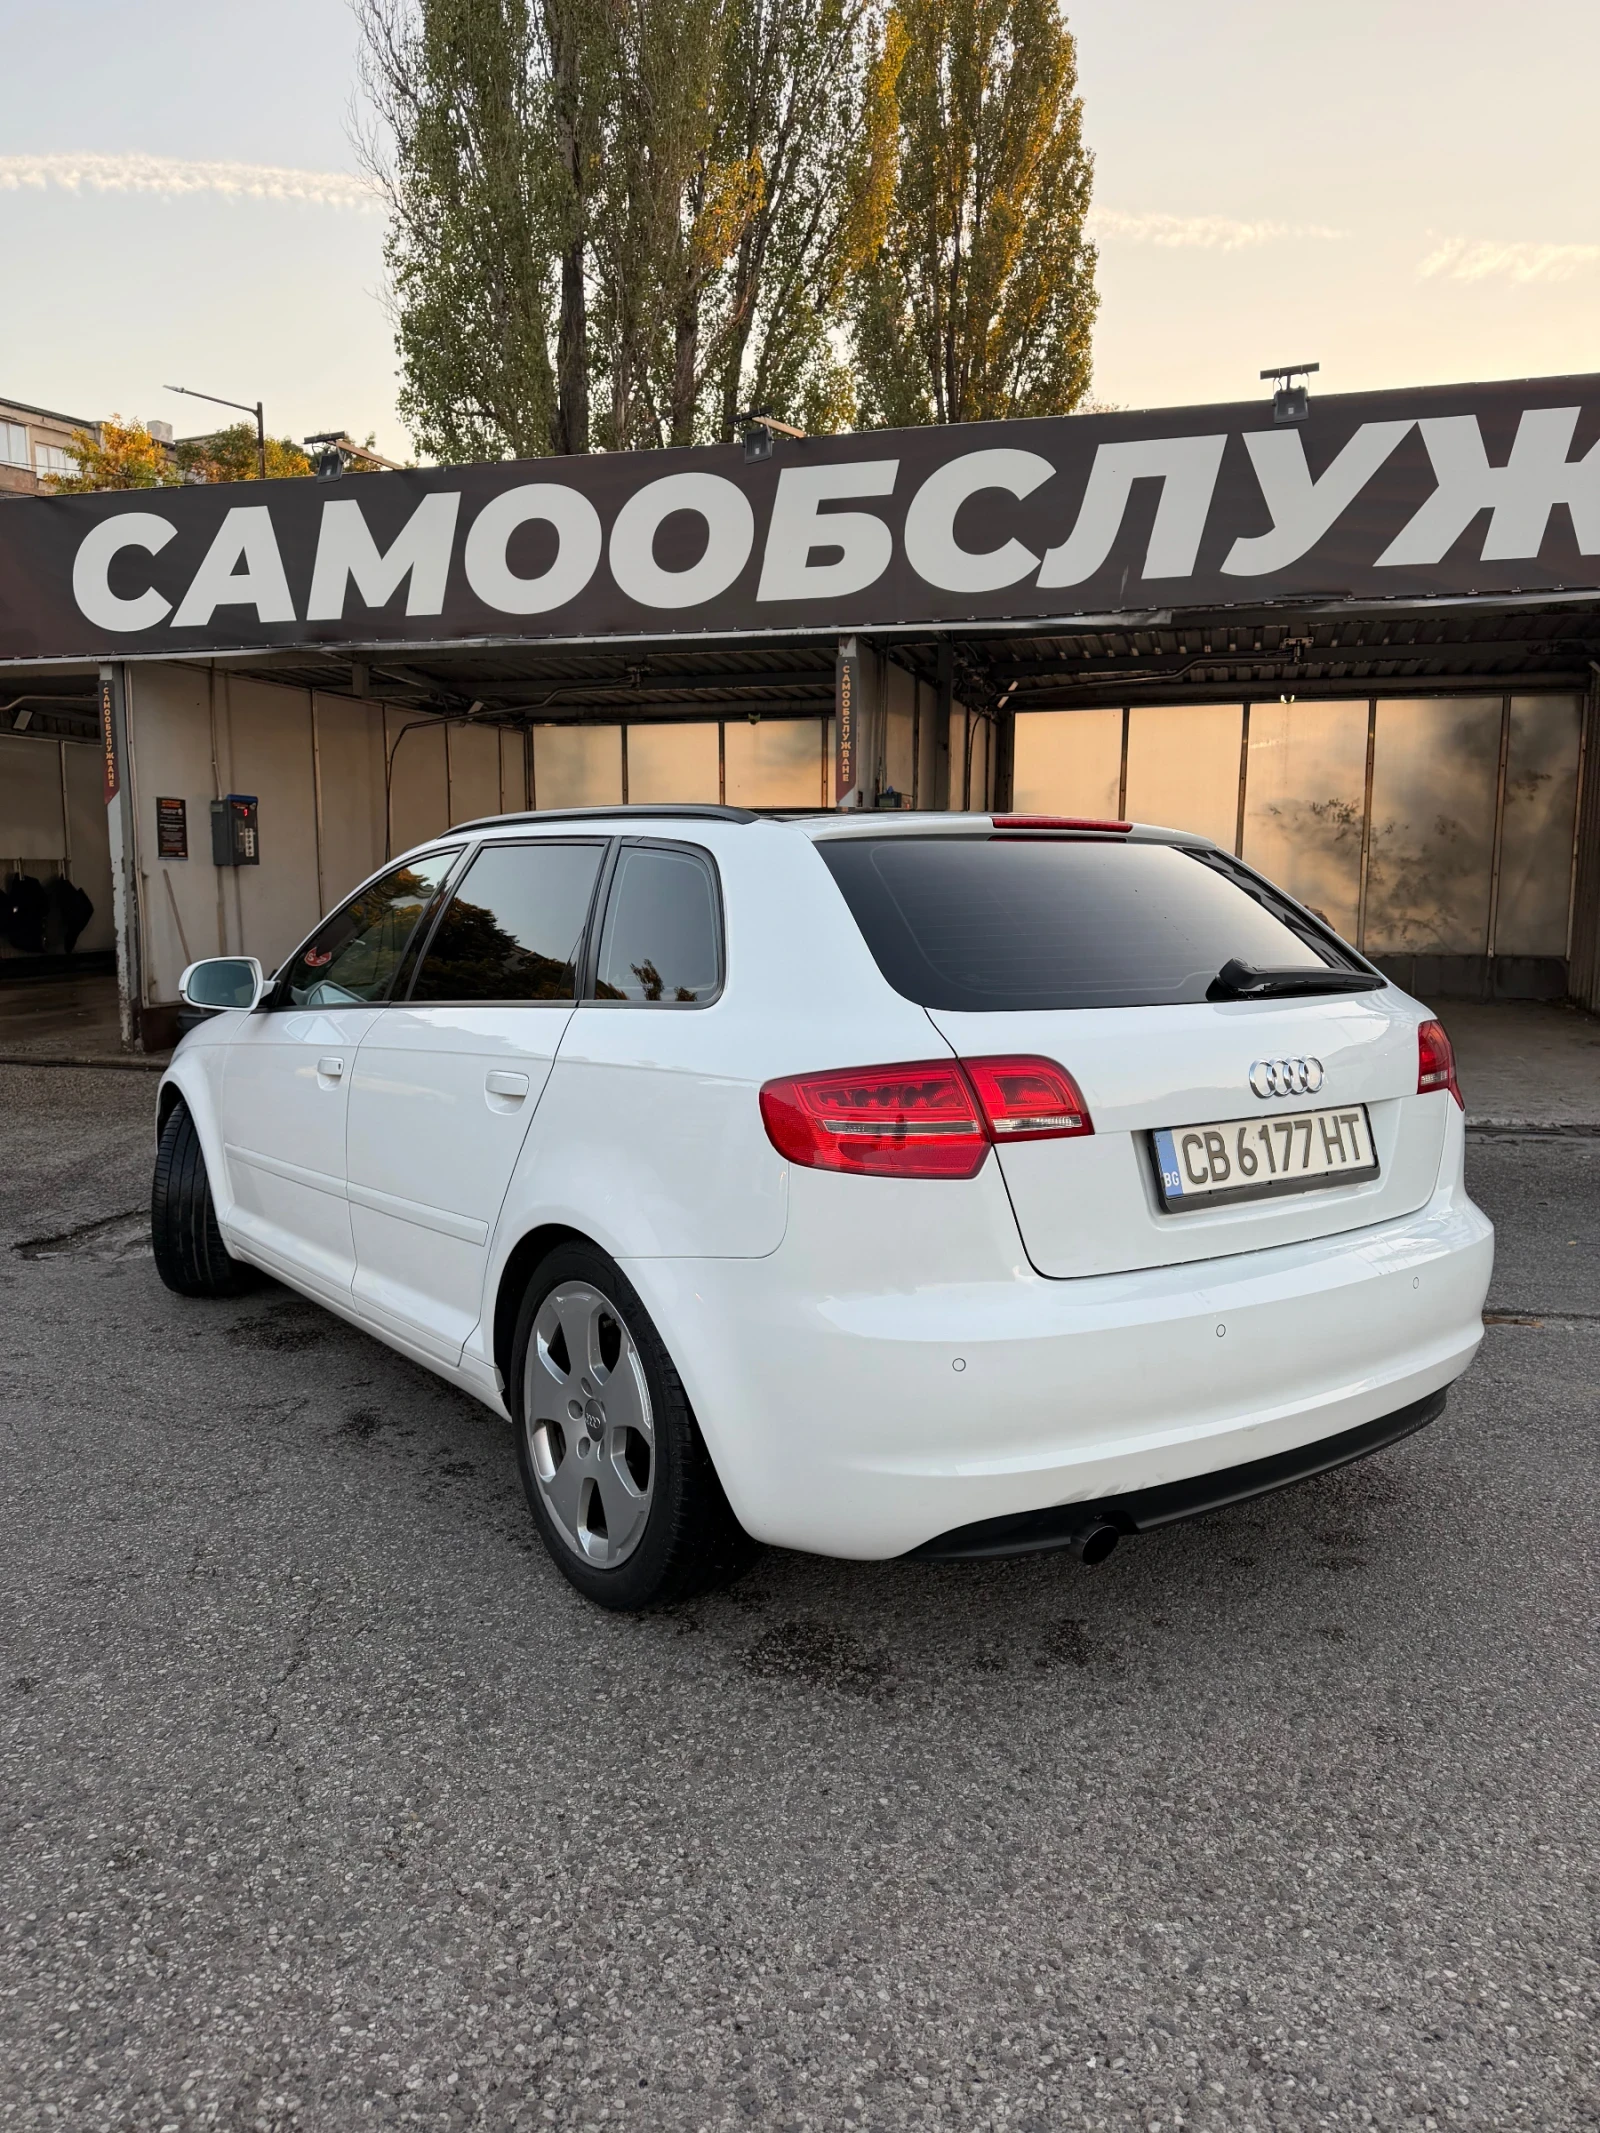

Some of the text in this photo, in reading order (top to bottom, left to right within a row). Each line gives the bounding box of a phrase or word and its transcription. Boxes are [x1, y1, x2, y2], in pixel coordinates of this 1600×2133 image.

[73, 406, 1600, 633] САМООБСЛУЖ
[103, 687, 115, 788] САМООБСЛУЖВАНЕ
[841, 665, 851, 782] САМООБСЛУЖВАНЕ
[1163, 1171, 1180, 1188] BG
